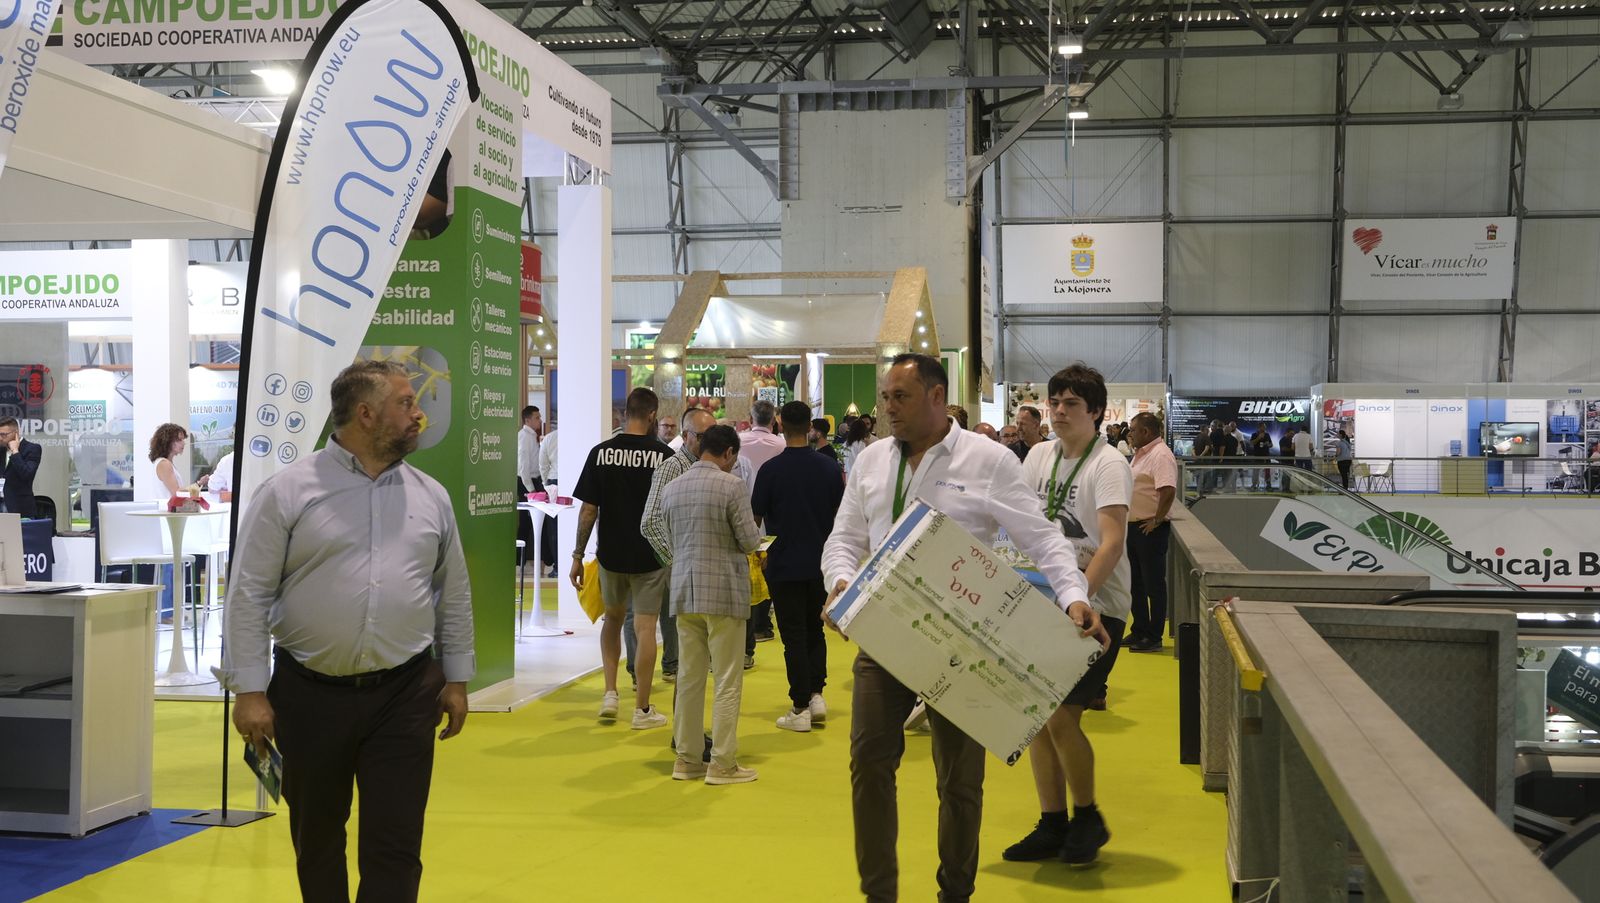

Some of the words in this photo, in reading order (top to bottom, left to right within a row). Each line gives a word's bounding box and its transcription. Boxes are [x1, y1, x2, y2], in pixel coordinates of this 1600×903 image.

[74, 31, 153, 48] SOCIEDAD
[158, 27, 267, 46] COOPERATIVA
[0, 38, 40, 134] peroxide
[286, 26, 362, 186] www.hpnow.eu
[480, 91, 514, 124] Vocación
[548, 84, 580, 117] Cultivando
[579, 106, 586, 120] el
[585, 108, 602, 129] futuro
[476, 114, 486, 132] de
[487, 122, 517, 148] servicio
[571, 119, 588, 140] desde
[388, 176, 419, 246] peroxide
[415, 129, 438, 176] made
[435, 77, 461, 129] simple
[479, 140, 486, 157] al
[488, 146, 508, 166] socio
[508, 156, 514, 172] y
[473, 161, 481, 178] al
[482, 167, 518, 193] agricultor
[485, 223, 516, 244] Suministros
[1374, 254, 1423, 269] Vícar
[1431, 253, 1488, 269] mucho
[484, 267, 513, 286] Semilleros
[1054, 286, 1066, 294] La
[1067, 285, 1112, 295] Mojonera
[1, 299, 67, 310] COOPERATIVA
[69, 298, 120, 308] ANDALUZA
[484, 302, 506, 318] Talleres
[484, 321, 513, 336] mecánicos
[484, 345, 513, 361] Estaciones
[484, 364, 491, 374] de
[491, 365, 512, 377] servicio
[483, 388, 502, 402] Riegos
[501, 392, 506, 405] y
[698, 387, 712, 397] AL
[483, 406, 514, 418] electricidad
[1238, 400, 1306, 414] BIHOX
[483, 432, 501, 446] Equipo
[482, 449, 503, 460] técnico
[476, 491, 514, 507] CAMPOEJIDO
[1313, 534, 1350, 562] El
[951, 555, 966, 571] 2
[1446, 546, 1572, 583] Unicaja
[1573, 664, 1586, 681] El
[1563, 679, 1599, 705] para
